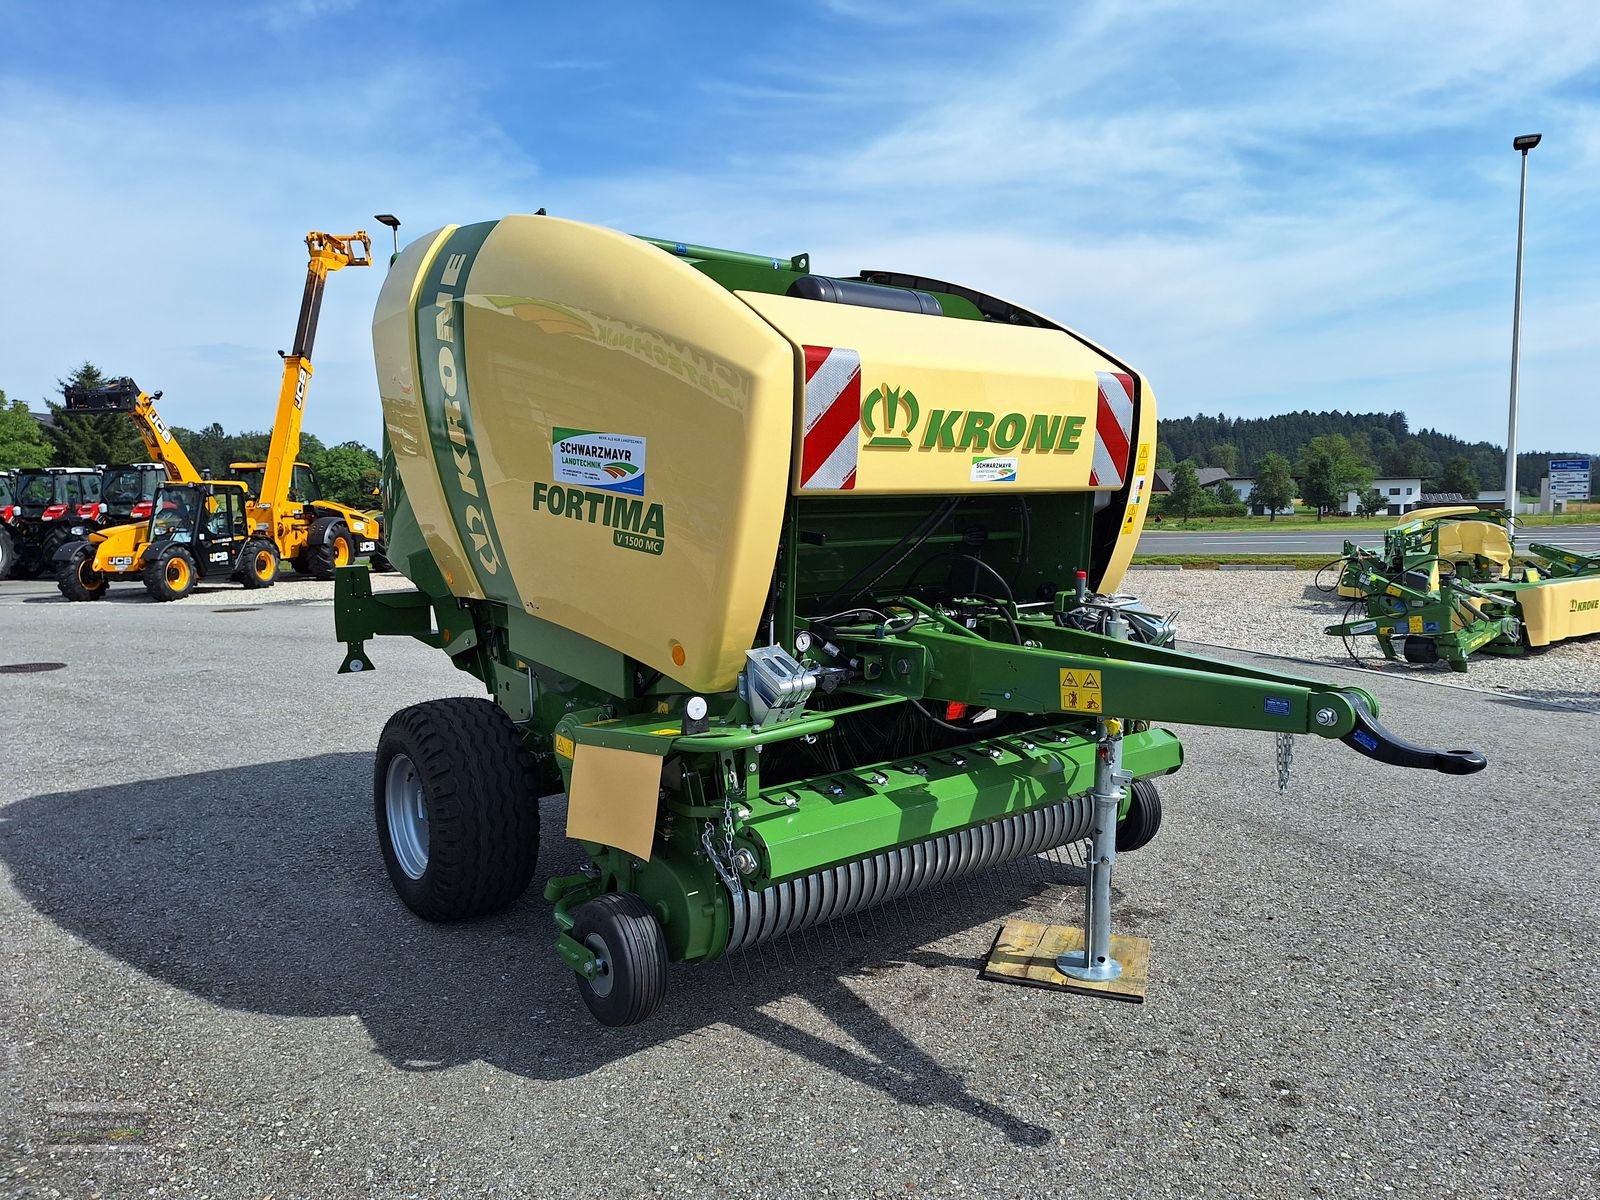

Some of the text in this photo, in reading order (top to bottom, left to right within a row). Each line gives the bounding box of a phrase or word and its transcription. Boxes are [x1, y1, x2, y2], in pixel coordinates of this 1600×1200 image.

[436, 253, 480, 498] KRONE
[295, 369, 306, 409] JCB
[149, 411, 171, 443] JCB
[918, 408, 1087, 454] KRONE
[560, 441, 632, 461] SCHWARZMAYR
[561, 456, 602, 470] LANDTECHNIK
[532, 481, 665, 538] FORTIMA
[360, 541, 375, 552] JCB
[616, 533, 660, 552] V 1500 MC
[108, 556, 133, 566] JCB
[209, 551, 229, 562] JCB
